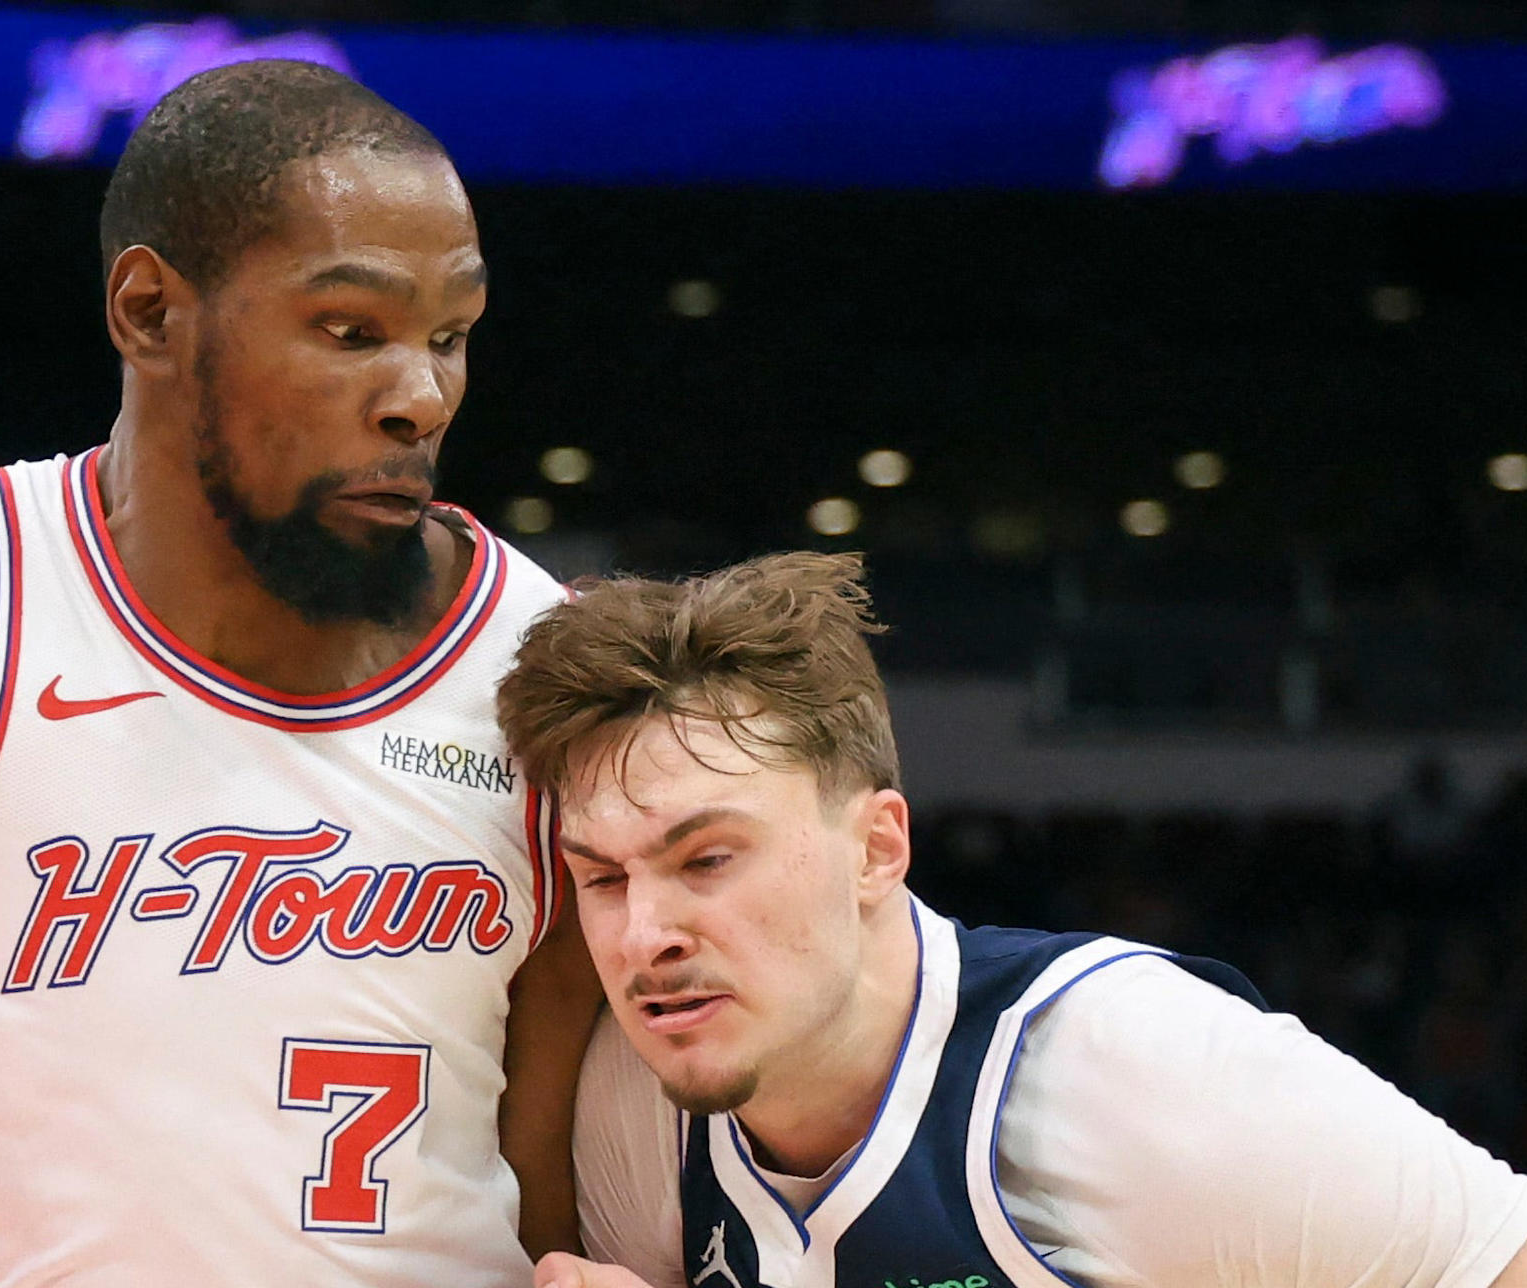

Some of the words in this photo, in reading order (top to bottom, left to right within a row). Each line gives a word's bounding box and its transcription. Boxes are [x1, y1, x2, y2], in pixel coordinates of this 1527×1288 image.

[380, 748, 515, 795] HERMANN
[381, 731, 517, 778] MEMORIAL
[1, 819, 514, 995] H-Town
[277, 1036, 432, 1235] 7
